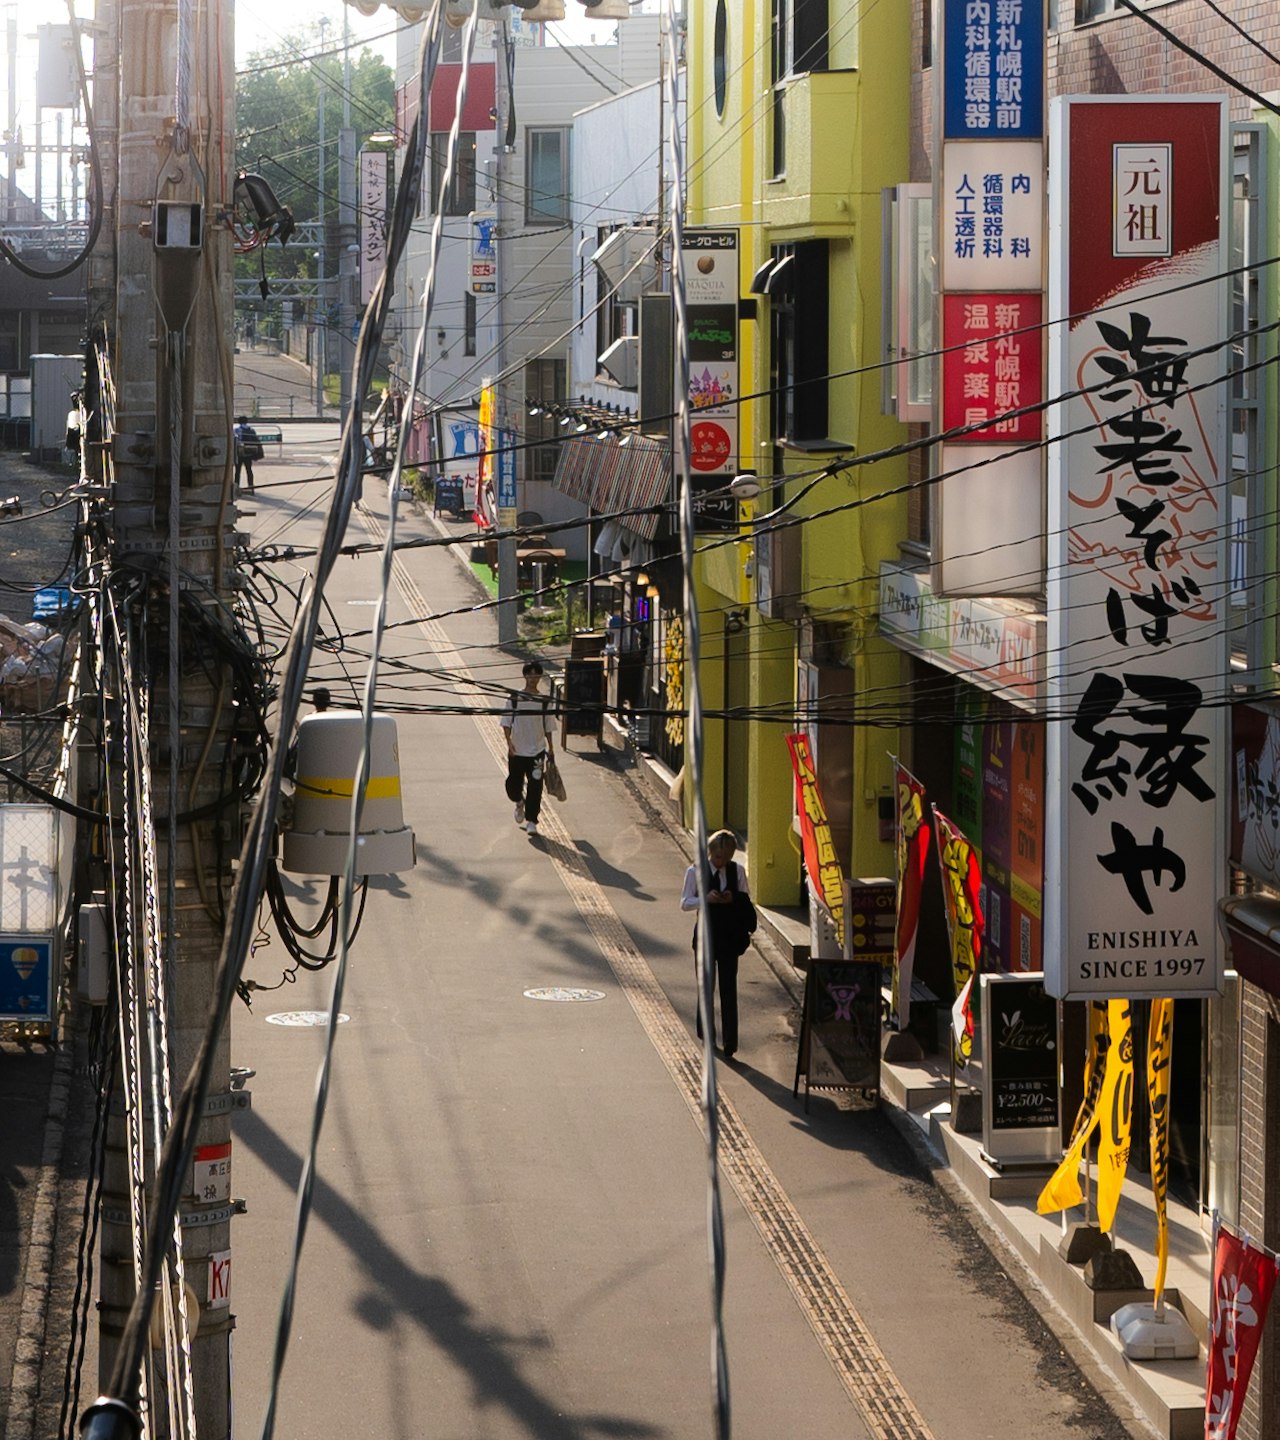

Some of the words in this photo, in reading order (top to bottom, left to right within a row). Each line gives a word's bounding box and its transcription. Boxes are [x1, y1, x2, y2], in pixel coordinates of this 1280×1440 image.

[965, 0, 991, 129] 内科循環器
[996, 0, 1022, 129] 新札幌駅前
[954, 173, 976, 259] 人工透析
[982, 173, 1004, 259] 循環器科
[1122, 159, 1162, 243] 元祖
[963, 303, 989, 435] 温泉薬局
[994, 303, 1020, 434] 新札幌駅前
[1070, 671, 1217, 916] 縁や
[1079, 959, 1149, 981] SINCE
[1153, 956, 1207, 979] 1997
[1086, 928, 1200, 950] ENISHIYA
